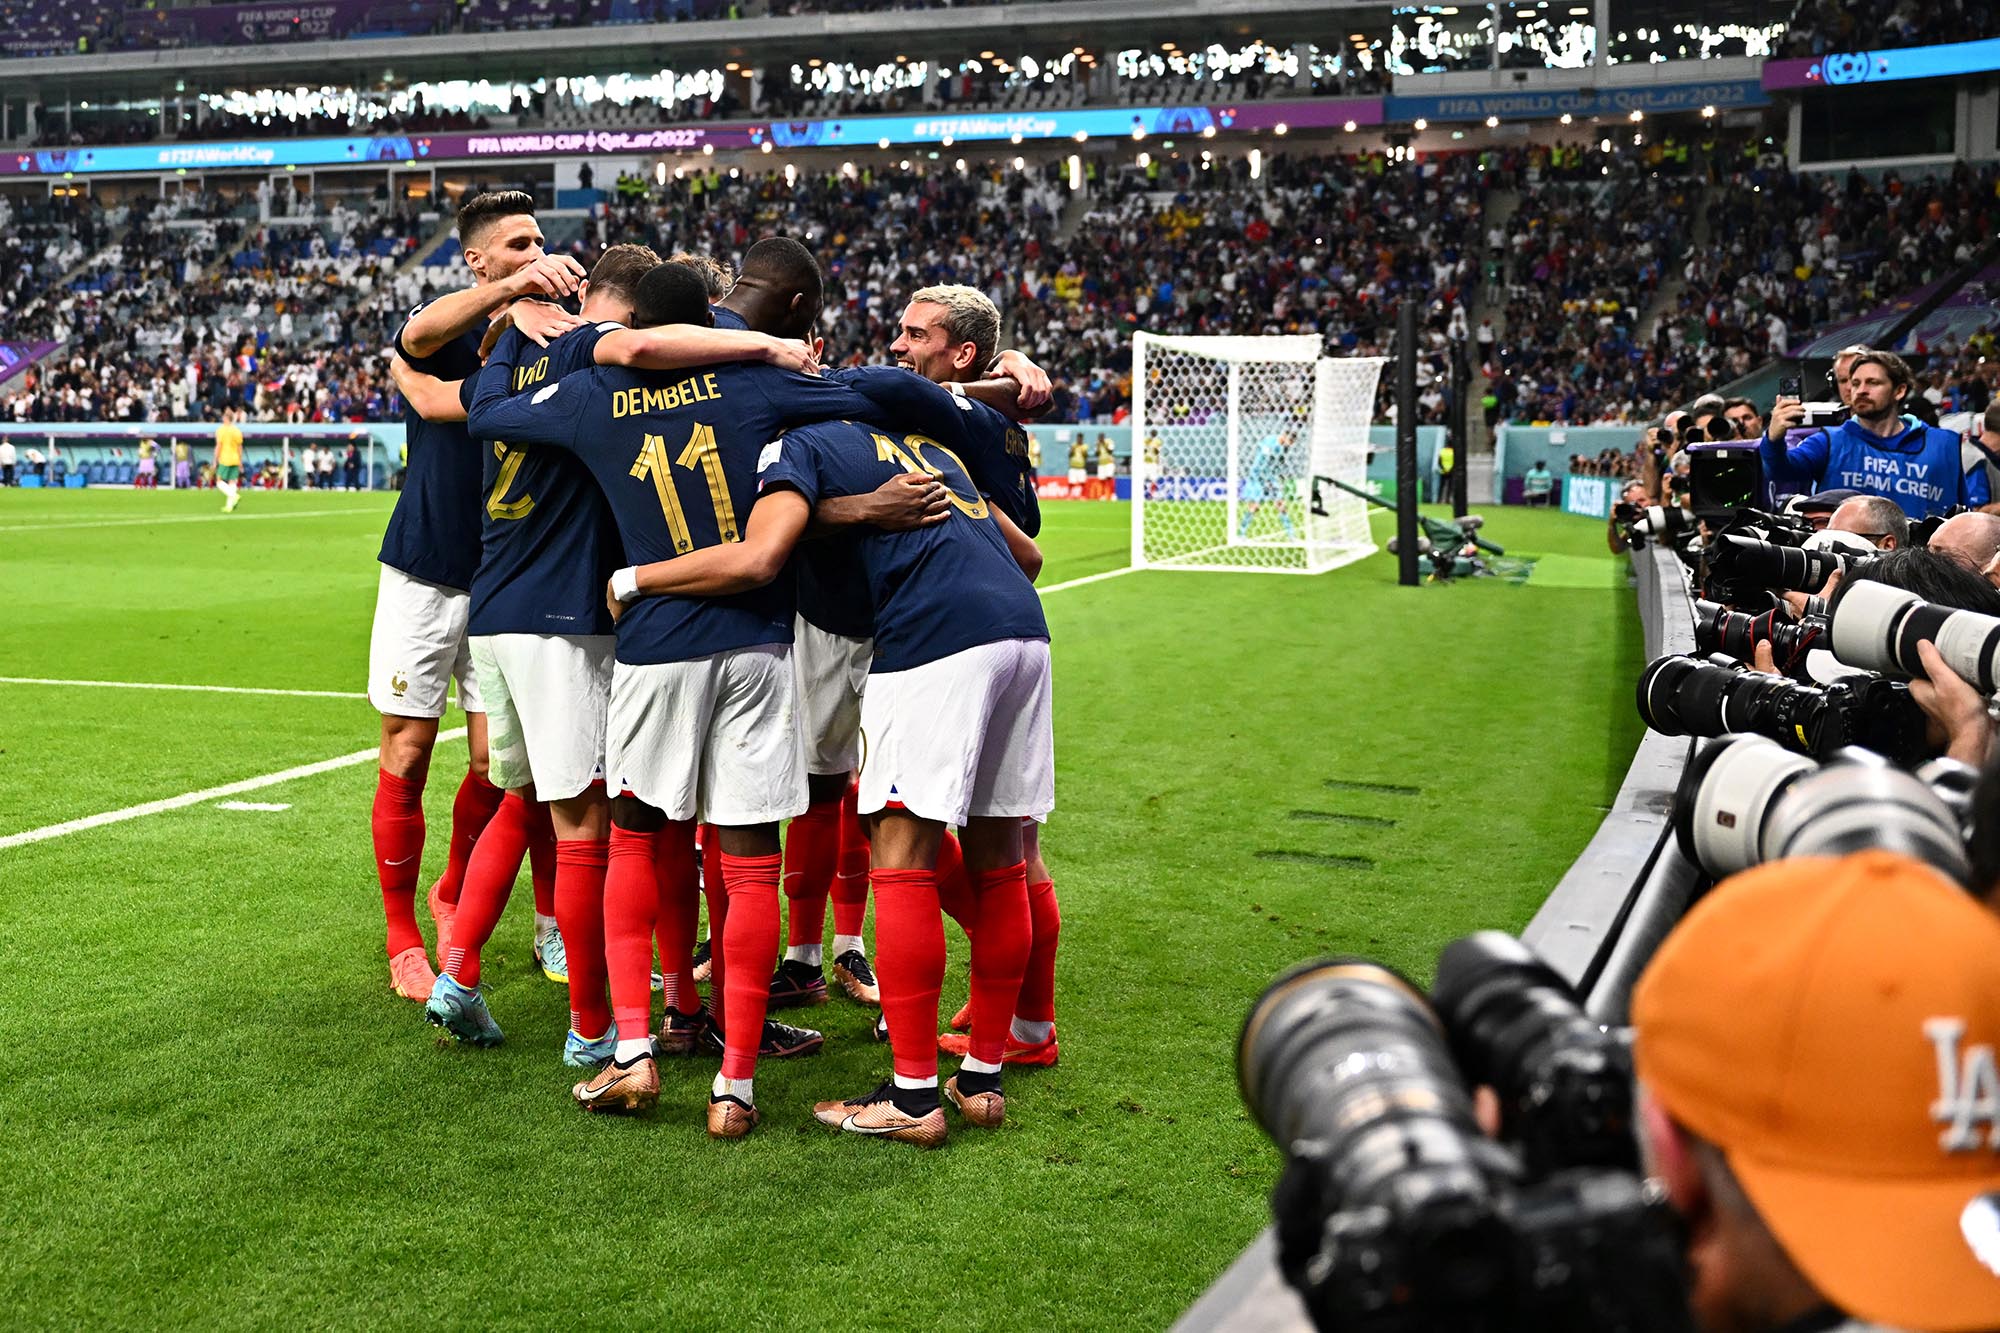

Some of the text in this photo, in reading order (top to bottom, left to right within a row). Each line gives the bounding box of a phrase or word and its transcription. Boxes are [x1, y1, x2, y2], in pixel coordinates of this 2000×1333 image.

[1439, 99, 1480, 115] FIFA
[1482, 96, 1553, 113] WORLD
[1556, 94, 1594, 110] CUP
[913, 116, 1058, 137] #FIFAWorldCup
[158, 146, 275, 165] #FIFAWorldCup
[468, 137, 500, 154] FIFA
[501, 134, 554, 152] WORLD
[554, 133, 585, 150] CUP
[612, 372, 722, 419] DEMBELE
[486, 440, 536, 522] 2
[869, 432, 990, 520] 10
[1863, 455, 1928, 480] FIFA TV
[628, 420, 741, 556] 11
[1841, 471, 1944, 502] TEAM CREW
[1921, 1014, 2000, 1152] LA
